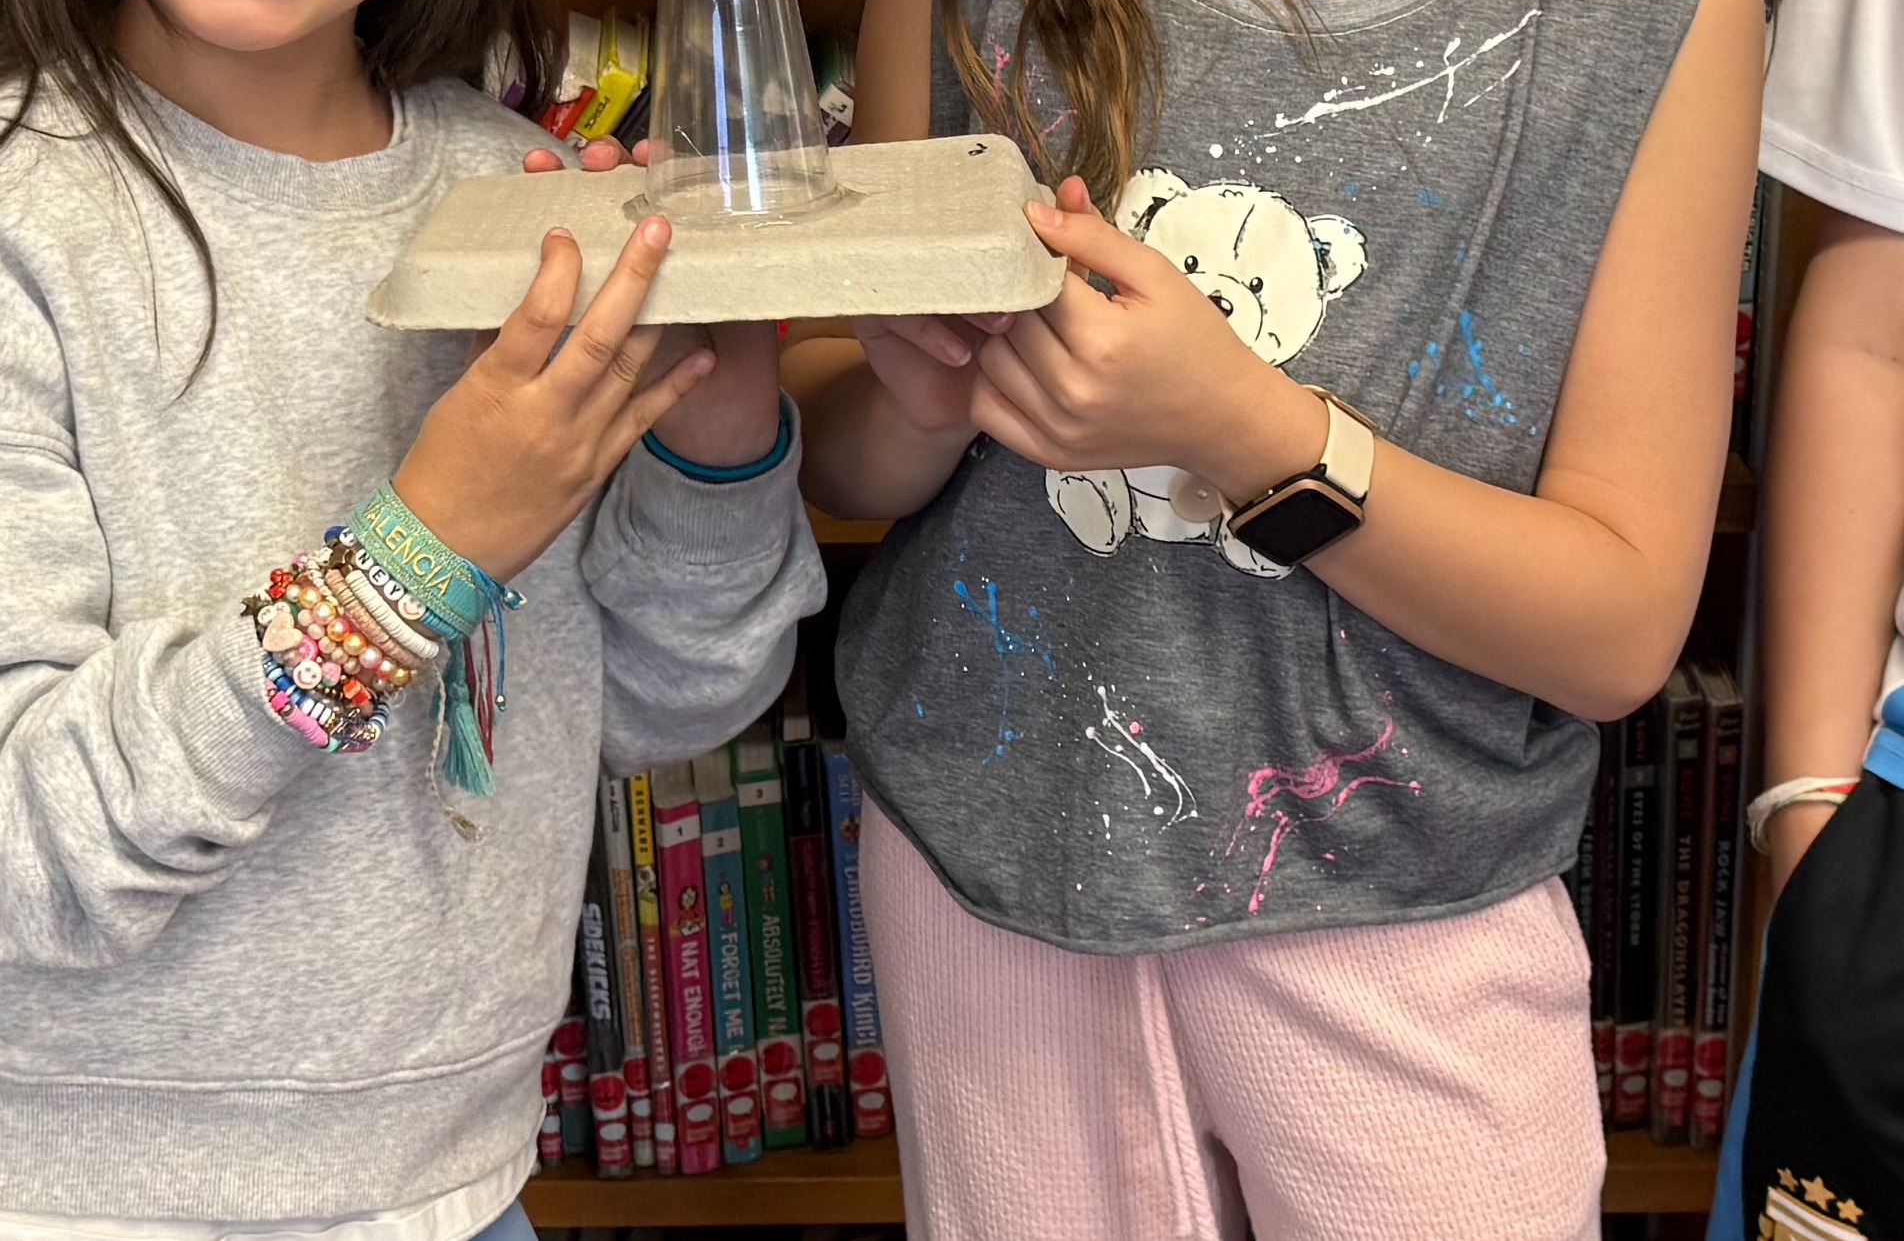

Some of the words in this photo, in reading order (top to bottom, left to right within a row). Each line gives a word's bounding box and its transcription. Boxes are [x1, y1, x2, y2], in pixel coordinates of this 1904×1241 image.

[1715, 839, 1732, 897] ROCK
[581, 902, 612, 1021] SIDEKICKS
[680, 940, 700, 980] NAT
[720, 931, 742, 1003] FORGET
[761, 913, 788, 1019] ABSOLUTELY
[723, 1007, 745, 1039] ME
